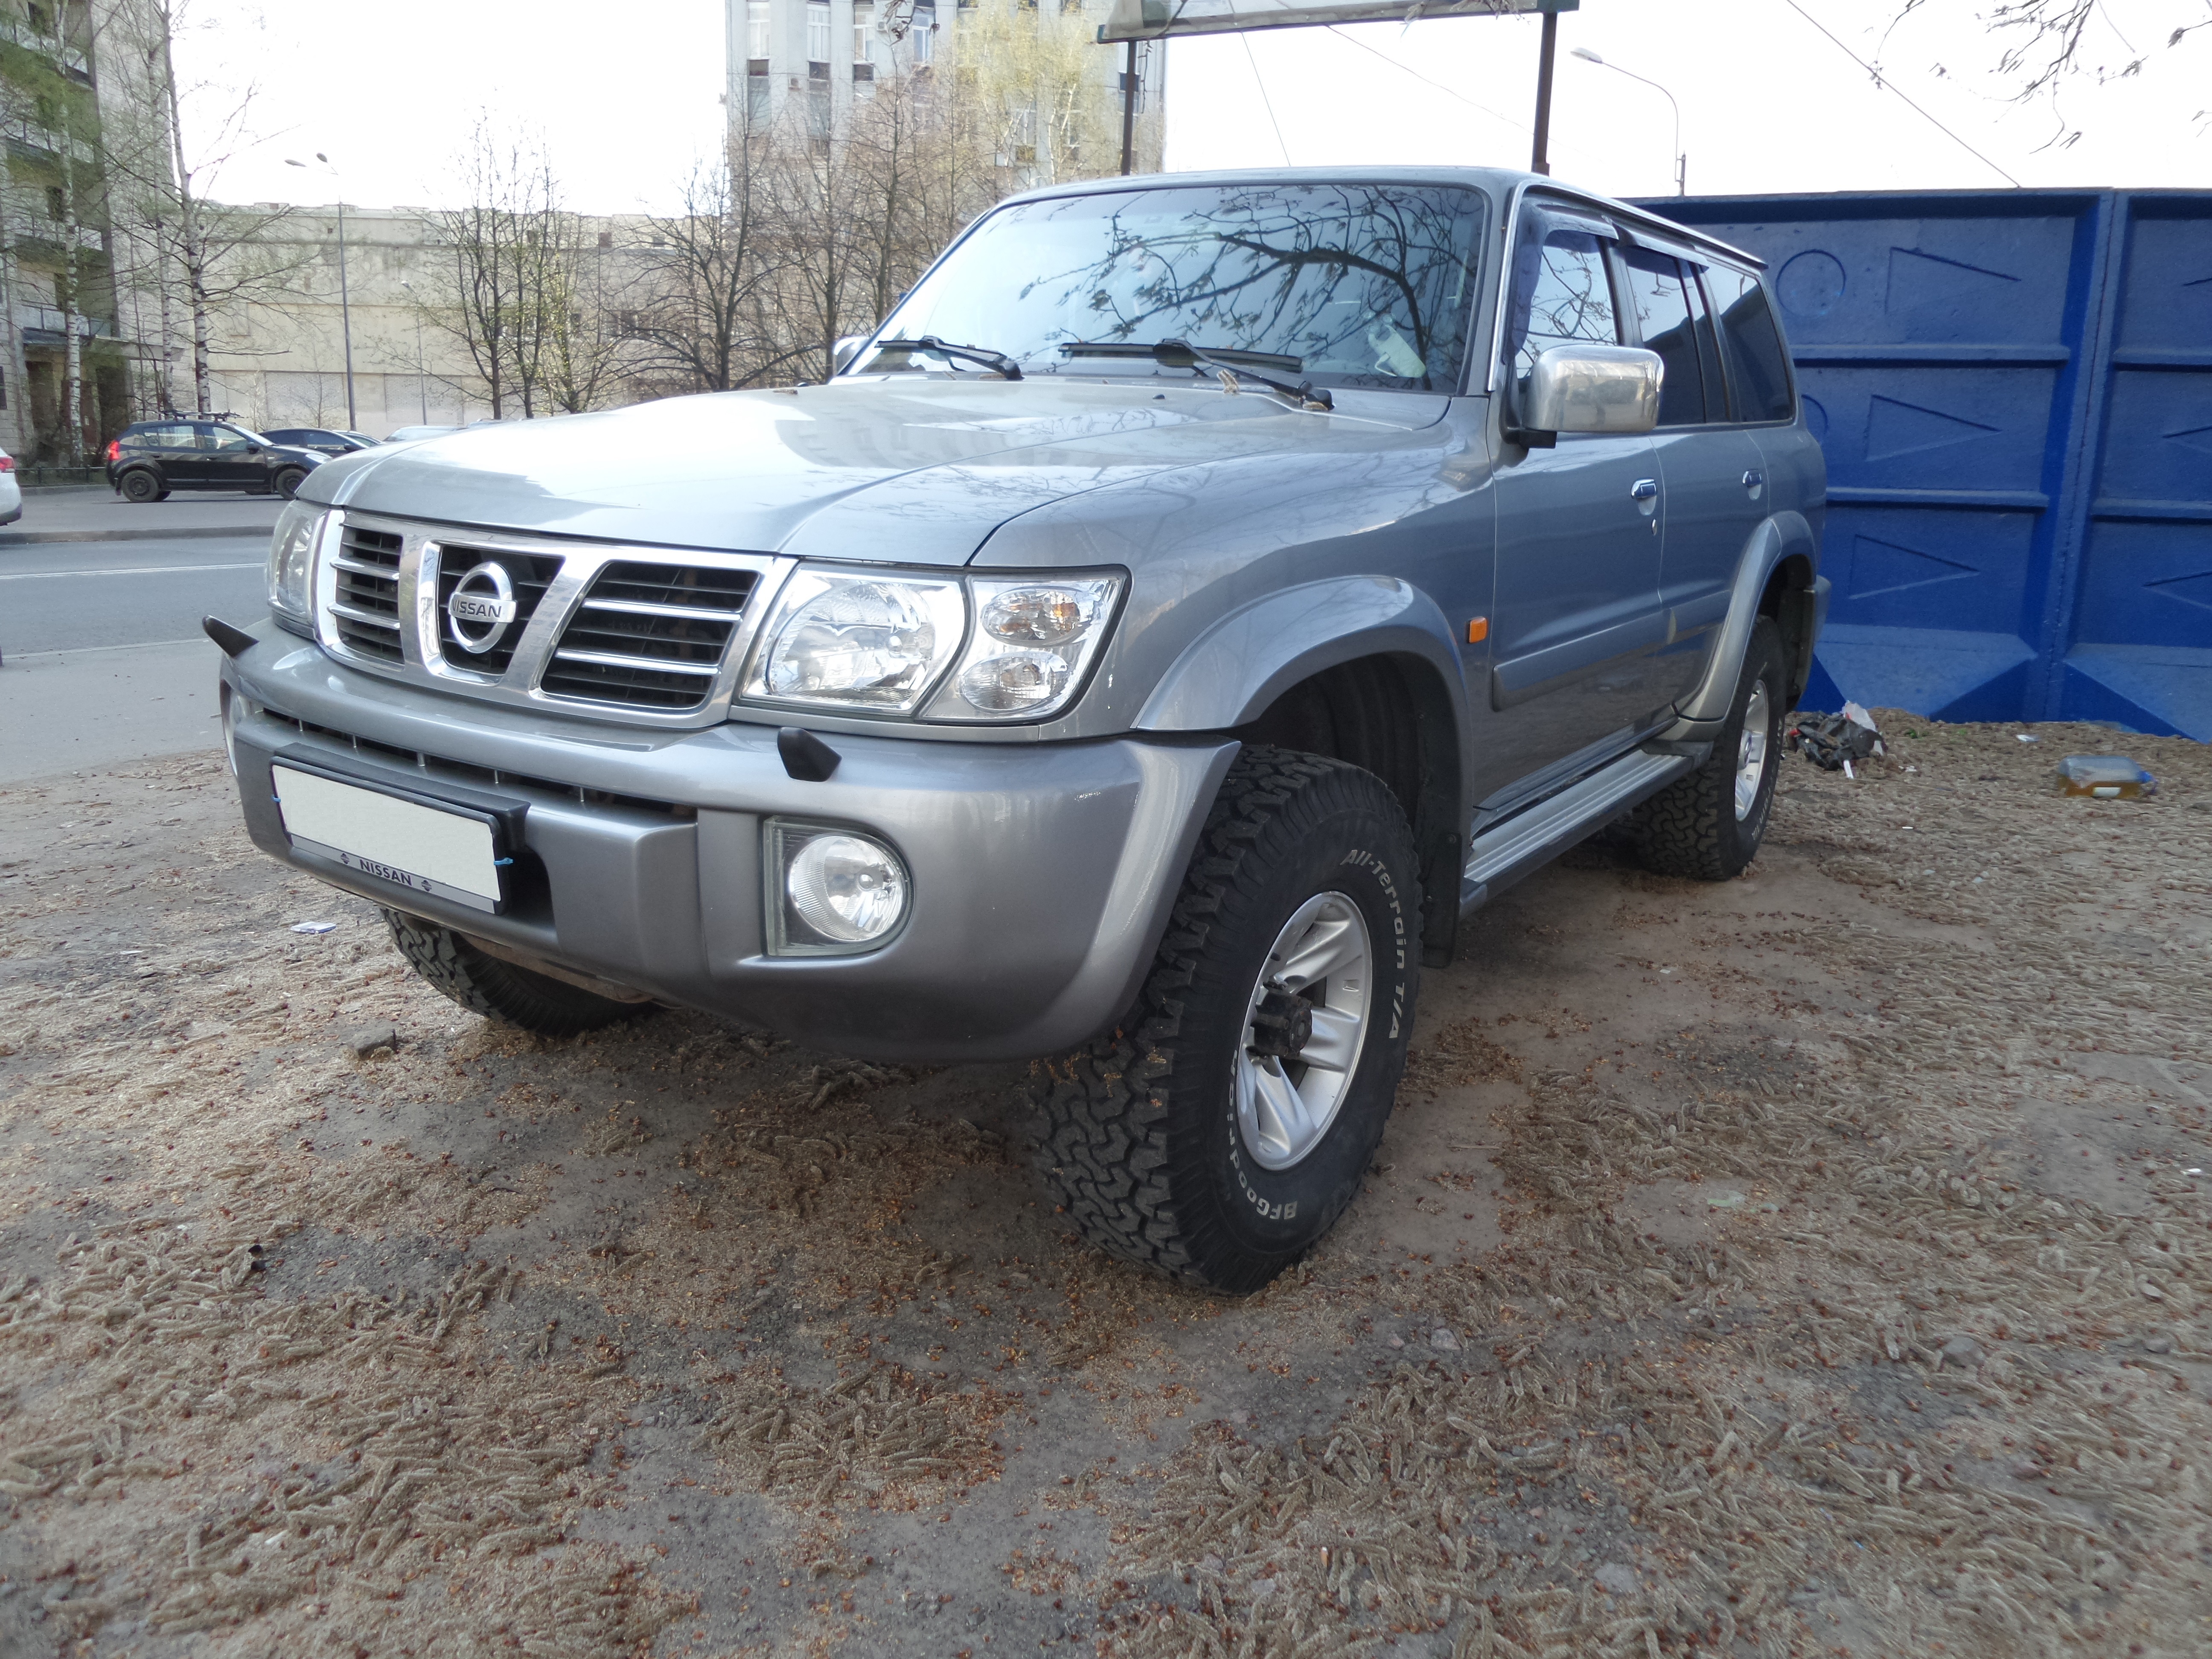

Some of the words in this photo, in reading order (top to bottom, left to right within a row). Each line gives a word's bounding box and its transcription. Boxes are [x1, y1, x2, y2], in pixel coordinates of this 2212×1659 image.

[451, 600, 502, 618] NISSAN
[359, 859, 413, 886] NISSAN
[1389, 982, 1405, 1039] T/A
